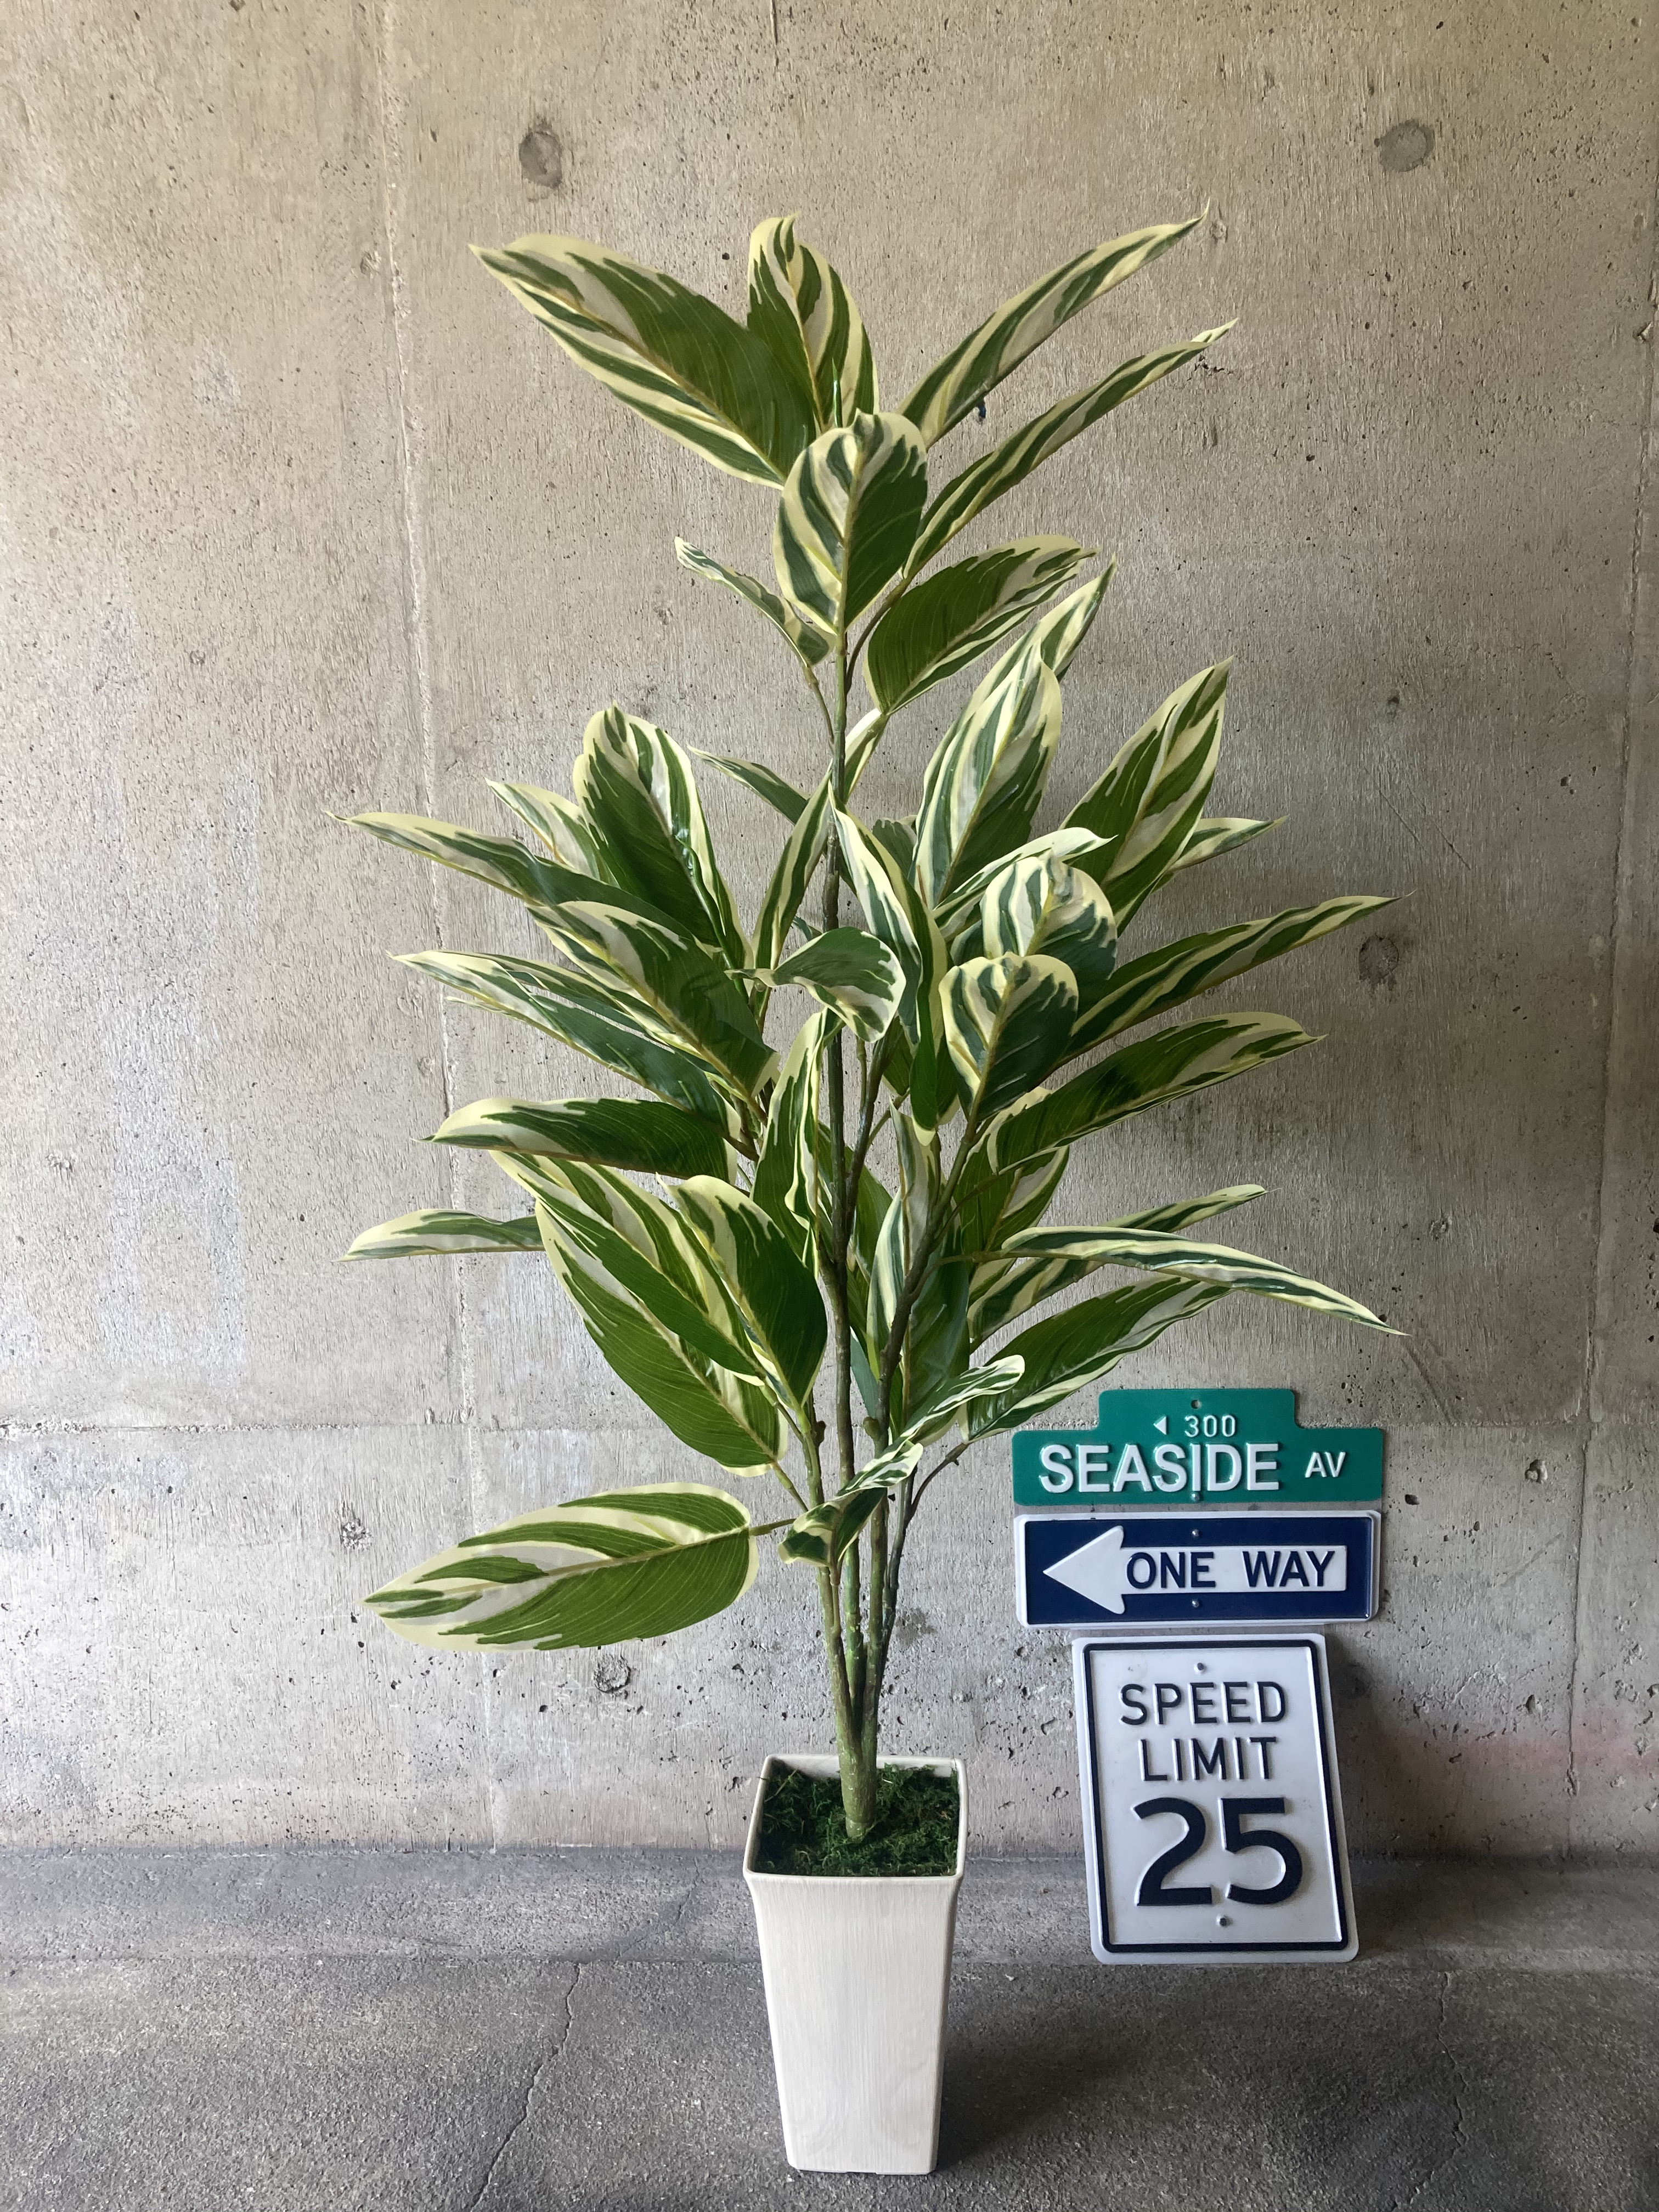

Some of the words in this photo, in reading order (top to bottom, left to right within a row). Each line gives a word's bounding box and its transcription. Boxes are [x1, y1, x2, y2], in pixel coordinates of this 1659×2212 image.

[1184, 1415, 1237, 1438] 300
[1039, 1443, 1280, 1493] SEASIDE
[1304, 1451, 1347, 1479] AV
[1126, 1551, 1216, 1589] ONE
[1242, 1550, 1335, 1588] WAY
[1120, 1680, 1286, 1725] SPEED
[1139, 1736, 1277, 1781] LIMIT
[1132, 1797, 1304, 1906] 25
